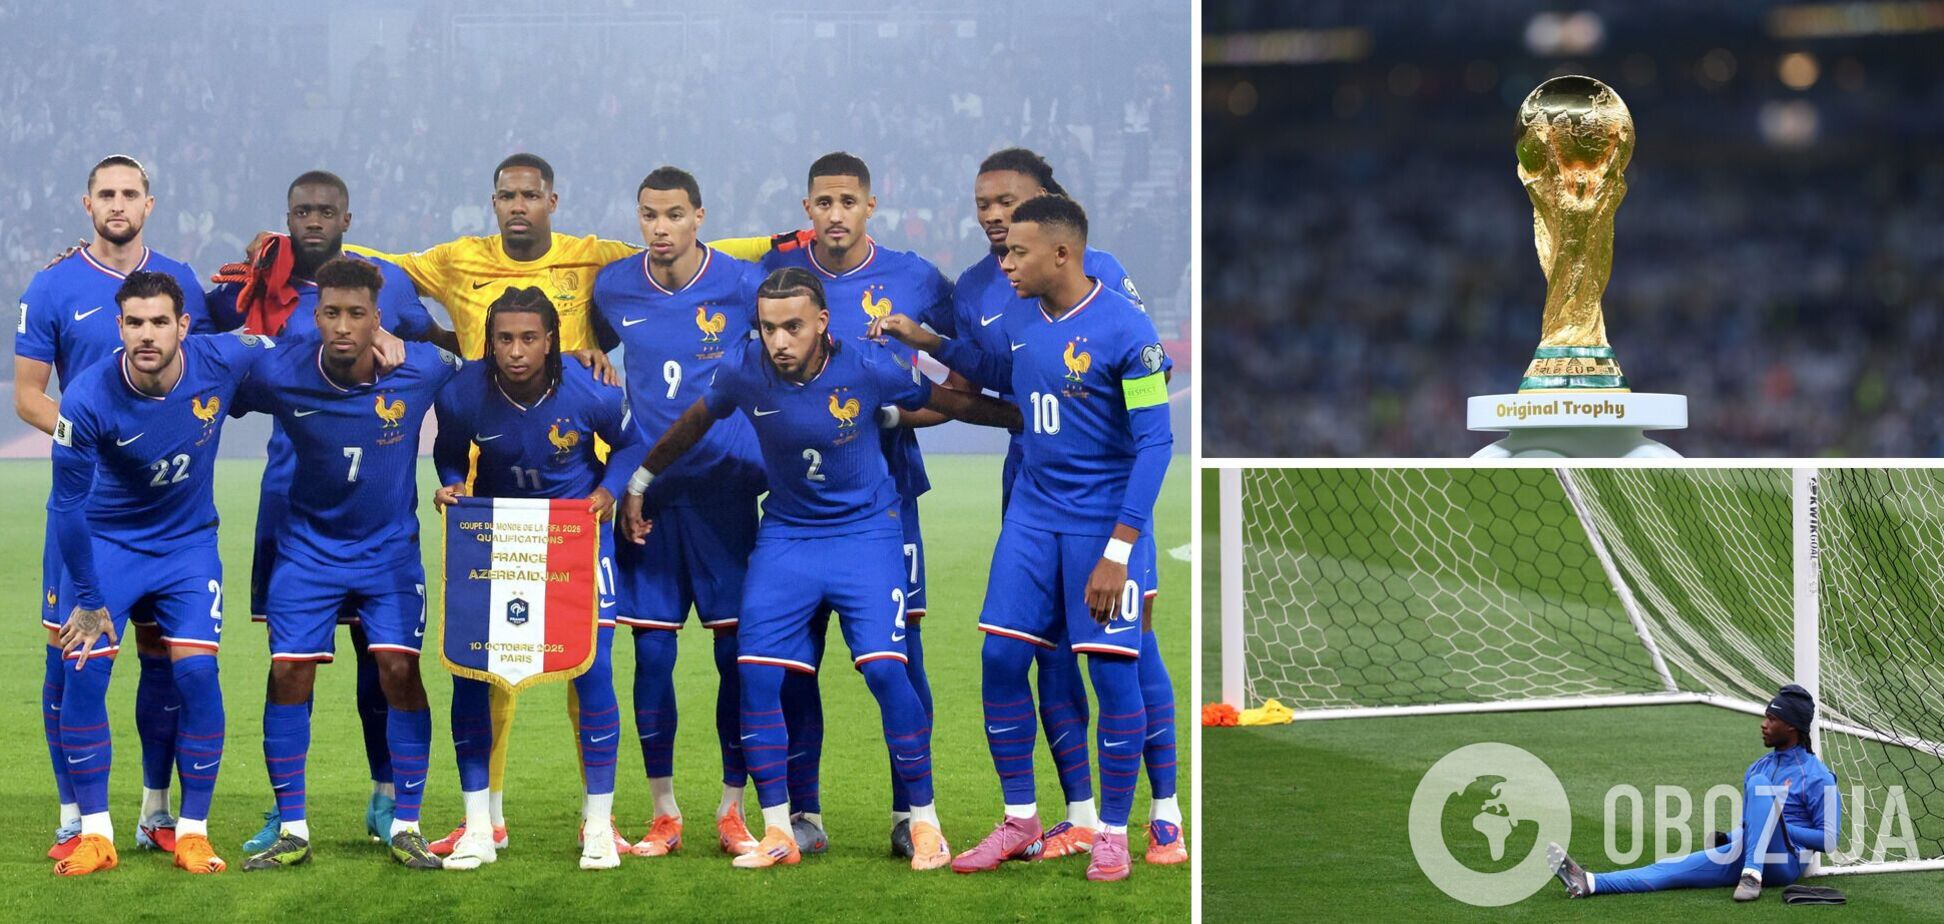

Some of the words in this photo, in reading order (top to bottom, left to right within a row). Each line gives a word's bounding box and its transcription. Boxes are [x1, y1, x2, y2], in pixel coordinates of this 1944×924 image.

[663, 360, 682, 399] 9
[1566, 366, 1595, 374] CUP
[1030, 391, 1060, 435] 10
[1496, 401, 1558, 420] Original
[1563, 400, 1625, 418] Trophy
[150, 453, 191, 487] 22
[343, 447, 363, 482] 7
[802, 448, 826, 481] 2
[511, 466, 542, 489] 11
[460, 521, 482, 530] COUPE
[484, 522, 494, 530] DU
[496, 522, 521, 532] MONDE
[523, 523, 533, 532] DE
[534, 523, 544, 532] LA
[476, 533, 564, 544] QUALIFICATIONS
[491, 552, 547, 563] FRANCE
[468, 569, 570, 582] AZERBAIDJAN
[891, 588, 905, 629] 2
[469, 641, 481, 651] 10
[485, 641, 535, 652] OCTOBRE
[536, 643, 564, 653] 2025
[500, 654, 532, 663] PARIS
